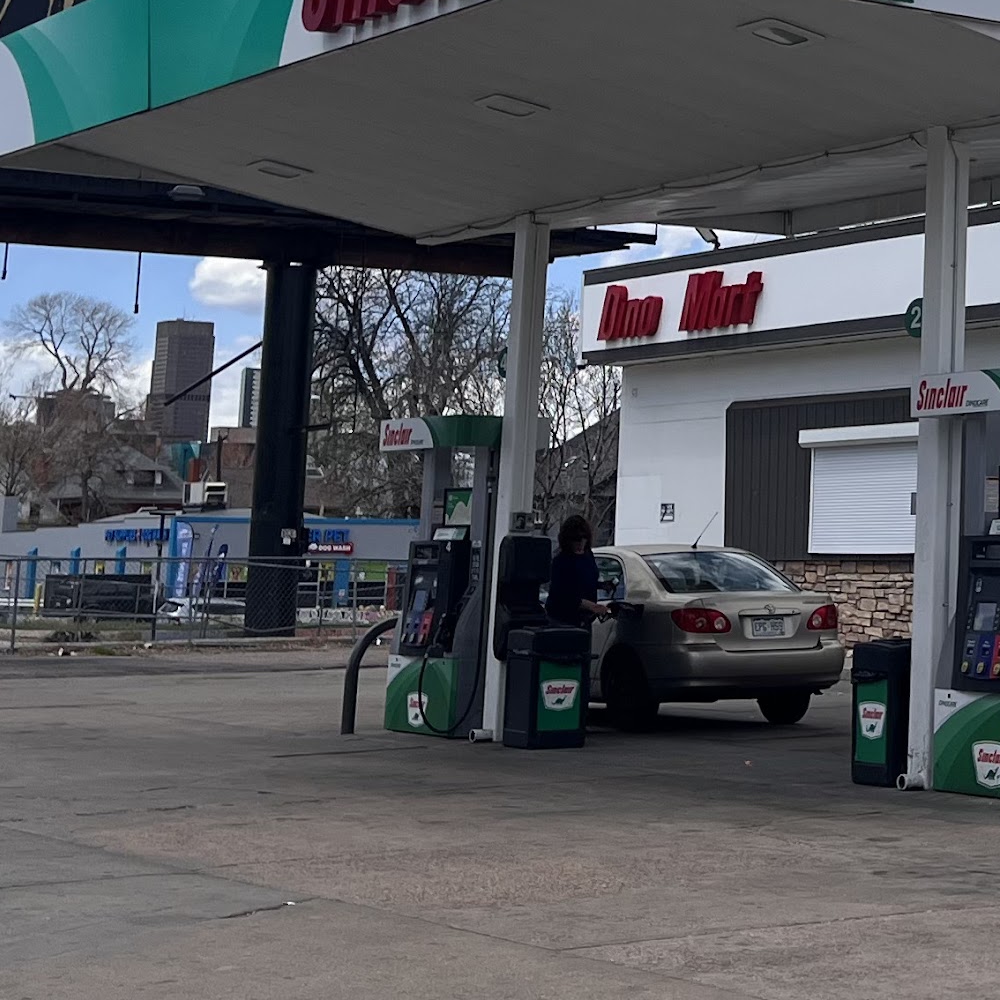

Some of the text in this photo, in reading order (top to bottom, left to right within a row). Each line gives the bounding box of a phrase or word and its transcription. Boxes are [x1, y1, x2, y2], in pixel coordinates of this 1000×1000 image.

[679, 271, 763, 331] Mart
[910, 306, 921, 329] 2
[917, 378, 968, 411] Sinclair
[383, 423, 413, 447] Sinclair
[445, 541, 451, 552] 4
[862, 708, 883, 720] Sinclair
